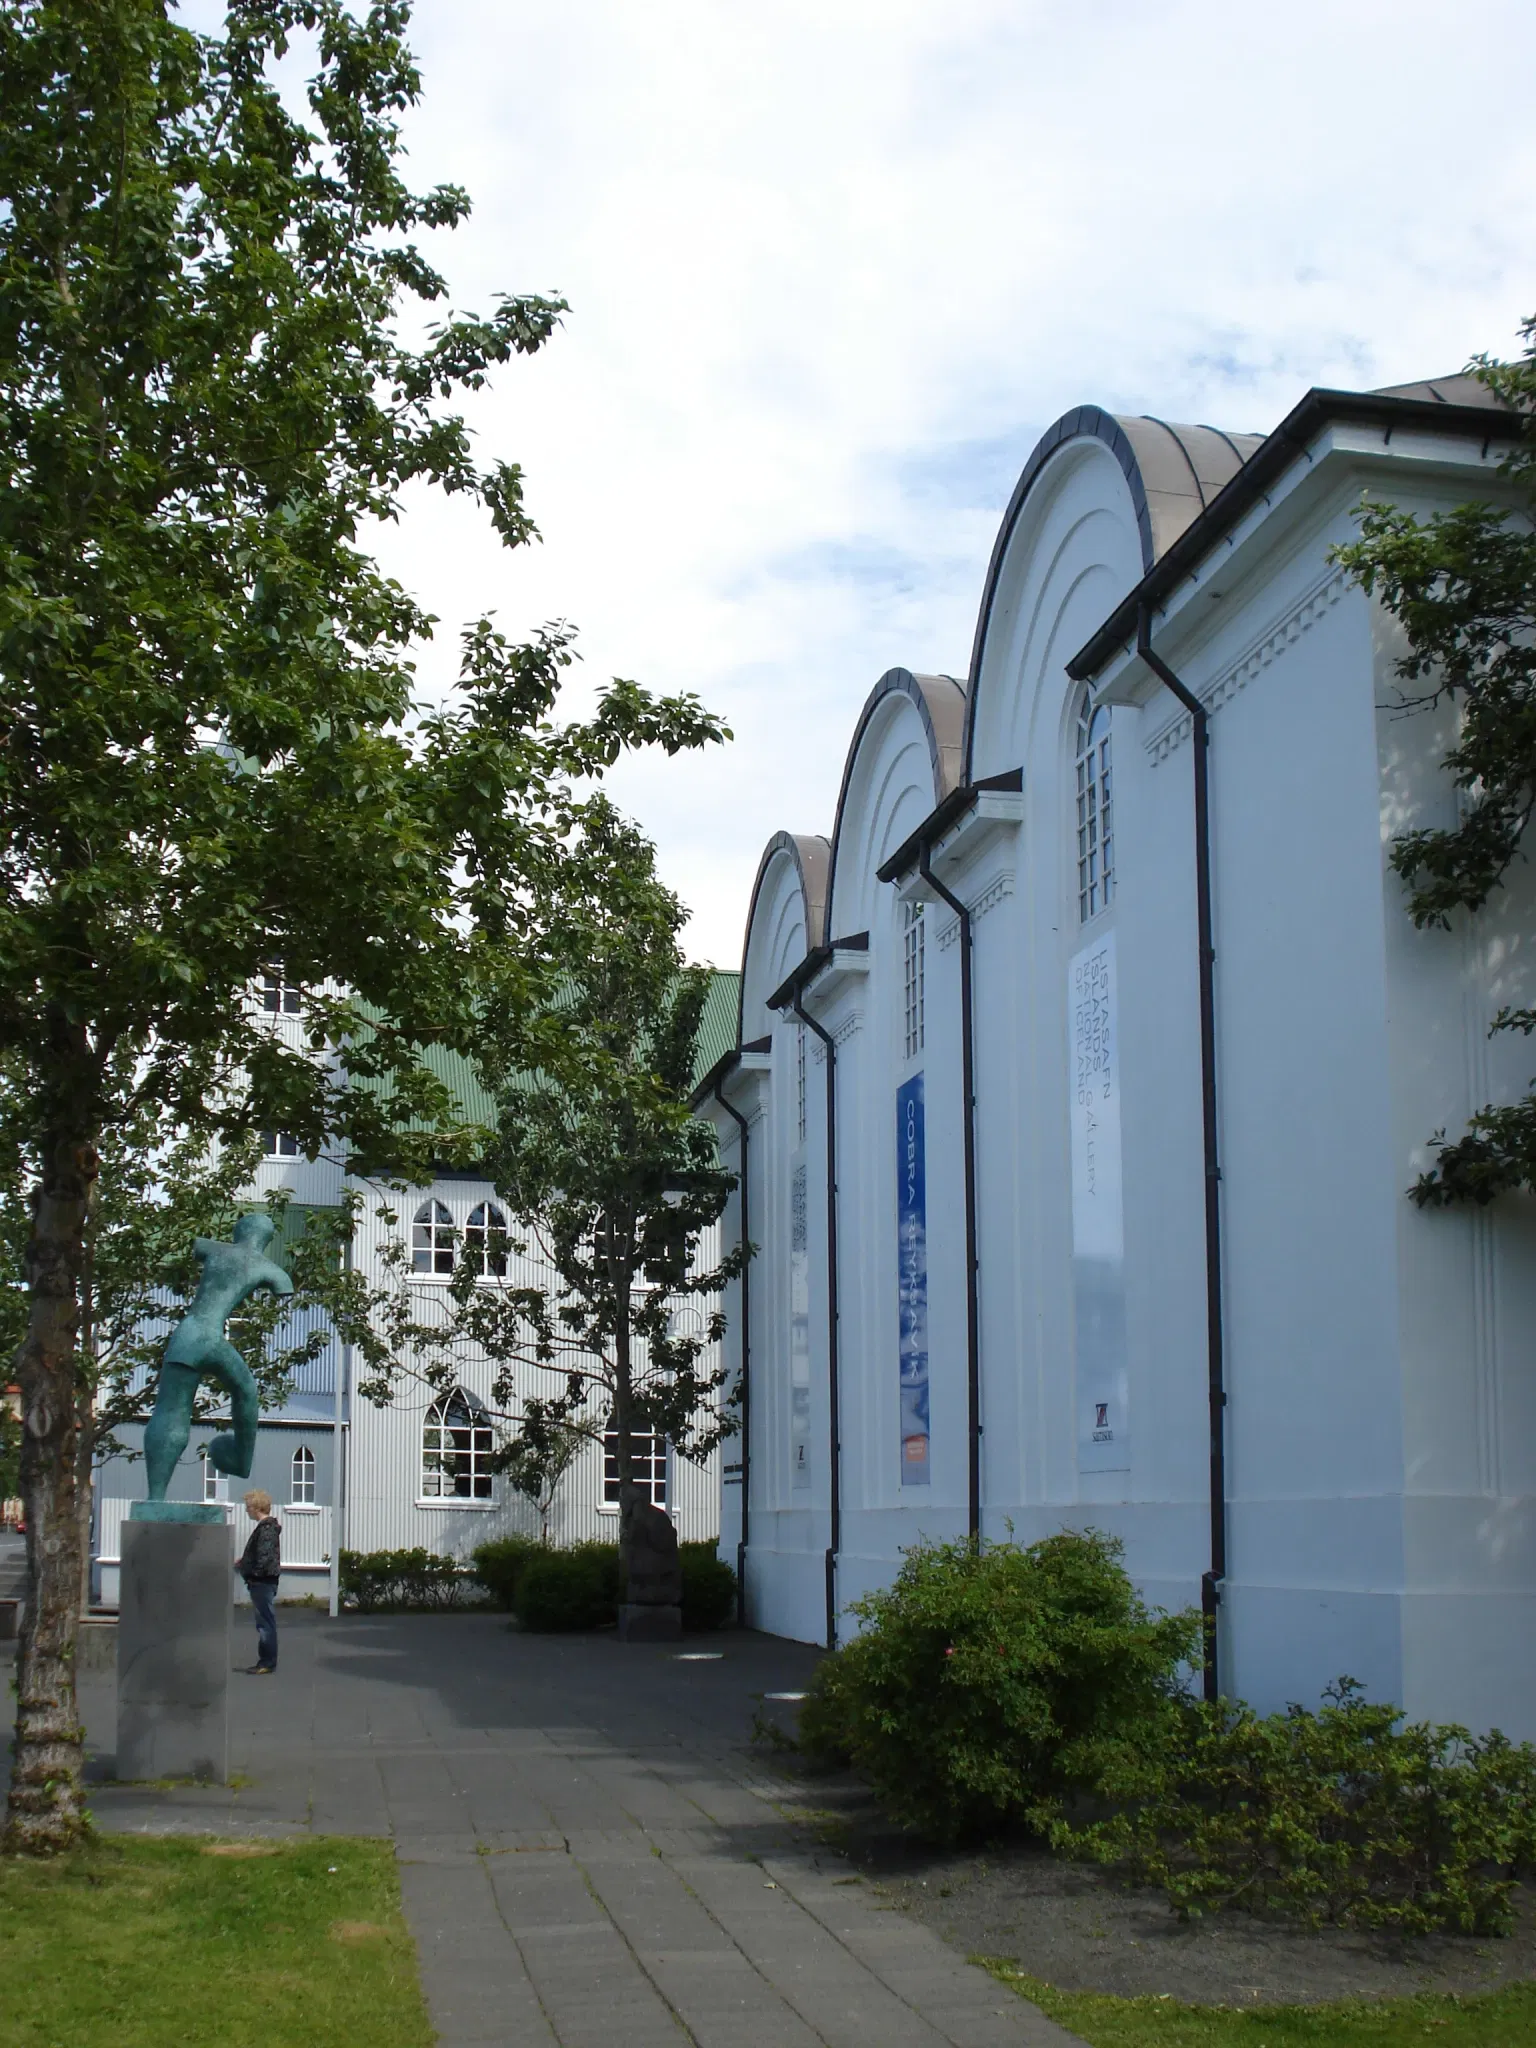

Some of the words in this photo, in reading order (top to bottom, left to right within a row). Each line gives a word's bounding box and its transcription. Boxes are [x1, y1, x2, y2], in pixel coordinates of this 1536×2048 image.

[1075, 967, 1083, 995] OF
[1083, 961, 1093, 1085] NATIONAL
[1099, 948, 1111, 1099] LISTASAFN
[1075, 1003, 1085, 1105] ICELAND
[906, 1099, 916, 1205] COBRA
[1085, 1090, 1096, 1196] GALLERY
